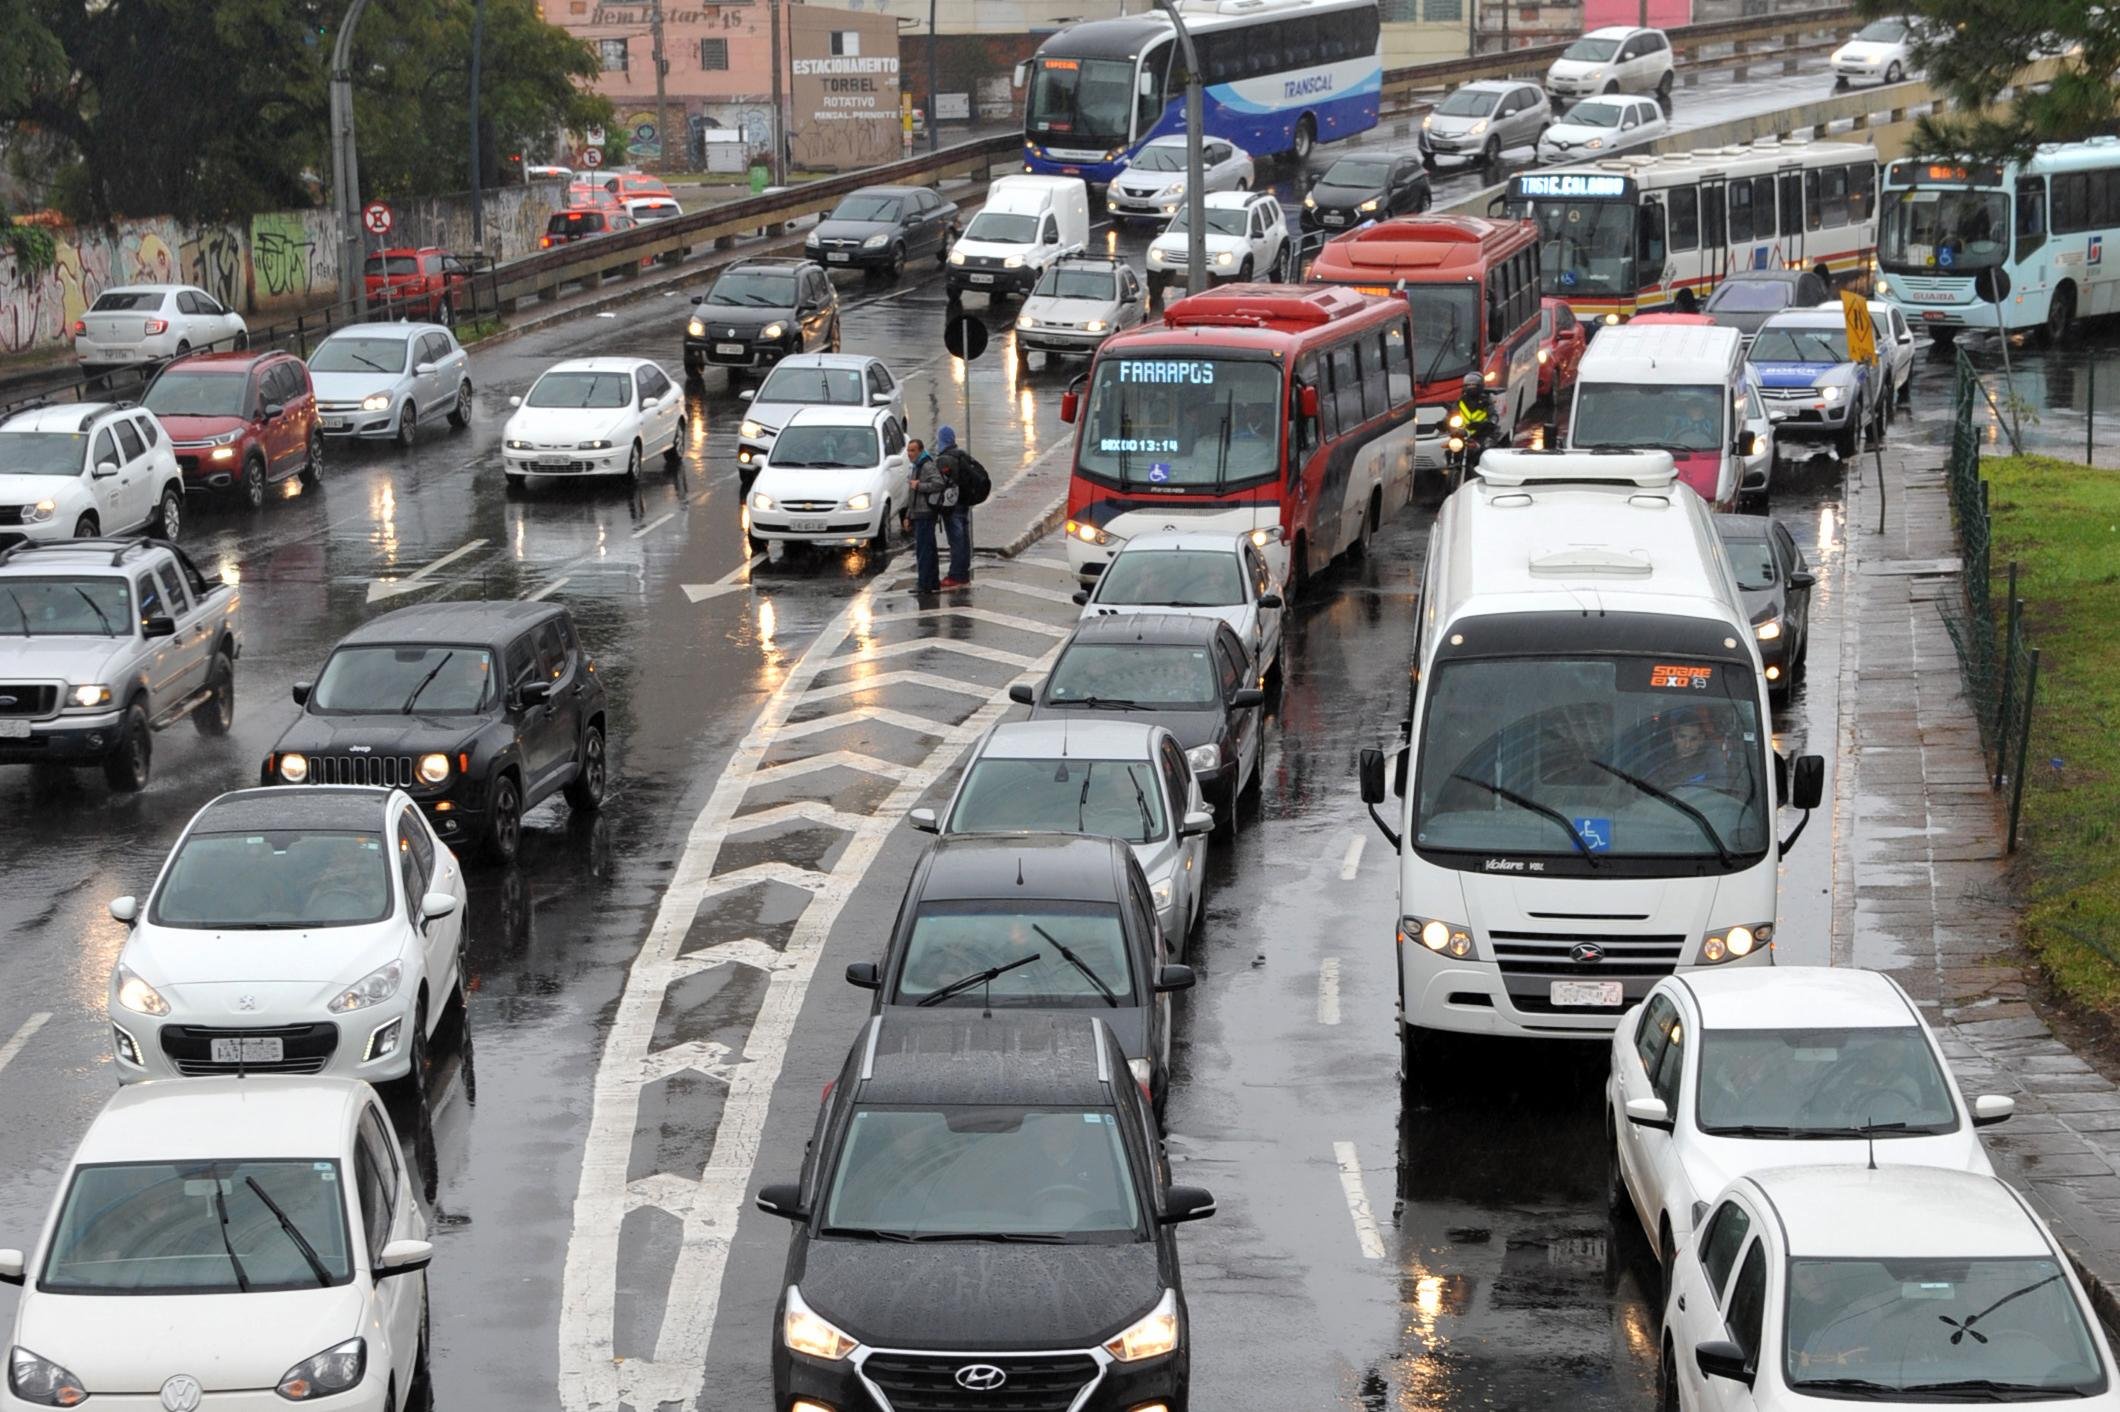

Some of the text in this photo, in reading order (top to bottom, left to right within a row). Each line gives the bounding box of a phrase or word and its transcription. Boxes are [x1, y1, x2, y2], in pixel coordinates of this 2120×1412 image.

[793, 58, 899, 75] ESTACIONAMENTO
[822, 78, 878, 93] TORBEL
[1284, 74, 1333, 99] TRANSCAL
[823, 96, 875, 108] ROTATIVO
[349, 745, 372, 753] Jeep
[1485, 859, 1525, 871] Volare
